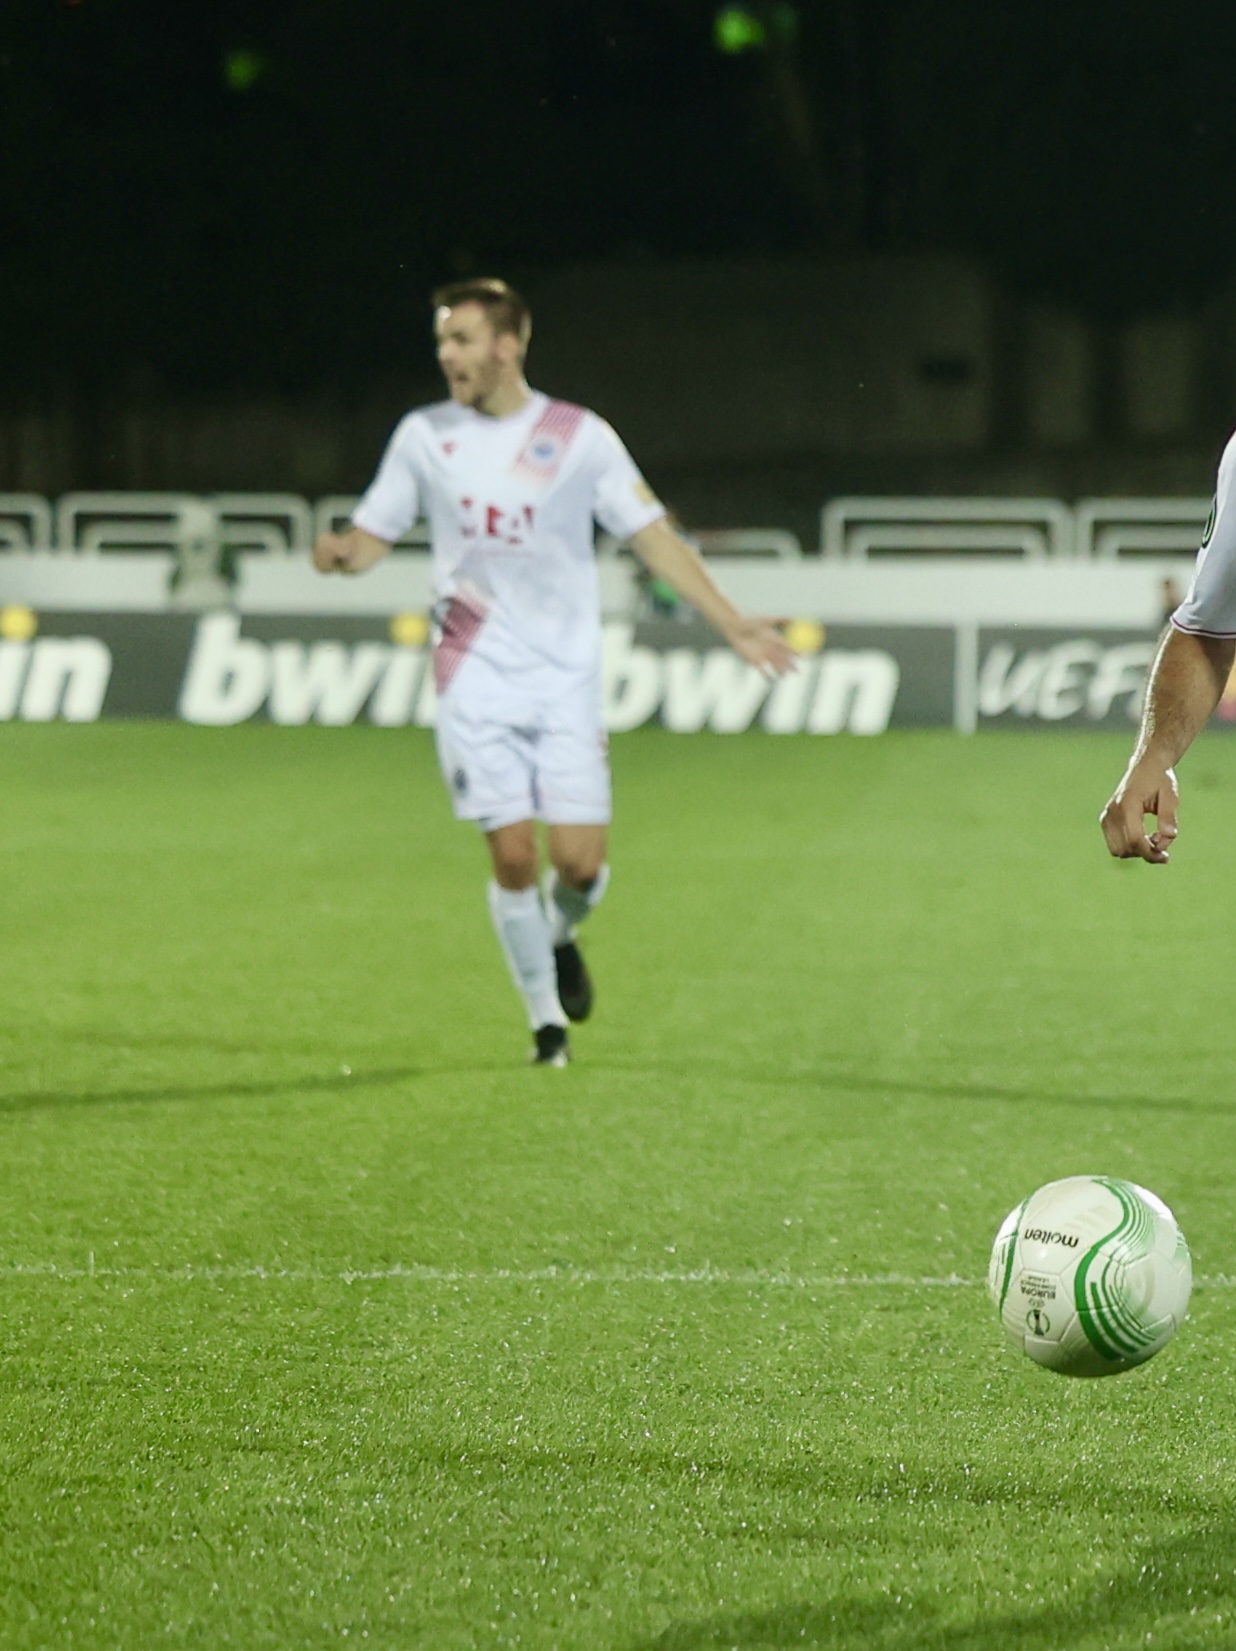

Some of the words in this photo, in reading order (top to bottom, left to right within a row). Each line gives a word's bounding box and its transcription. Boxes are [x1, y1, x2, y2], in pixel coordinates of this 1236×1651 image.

[179, 603, 437, 726] bwi
[600, 618, 898, 735] bwin
[978, 640, 1152, 721] UEF
[1024, 1228, 1079, 1248] molten
